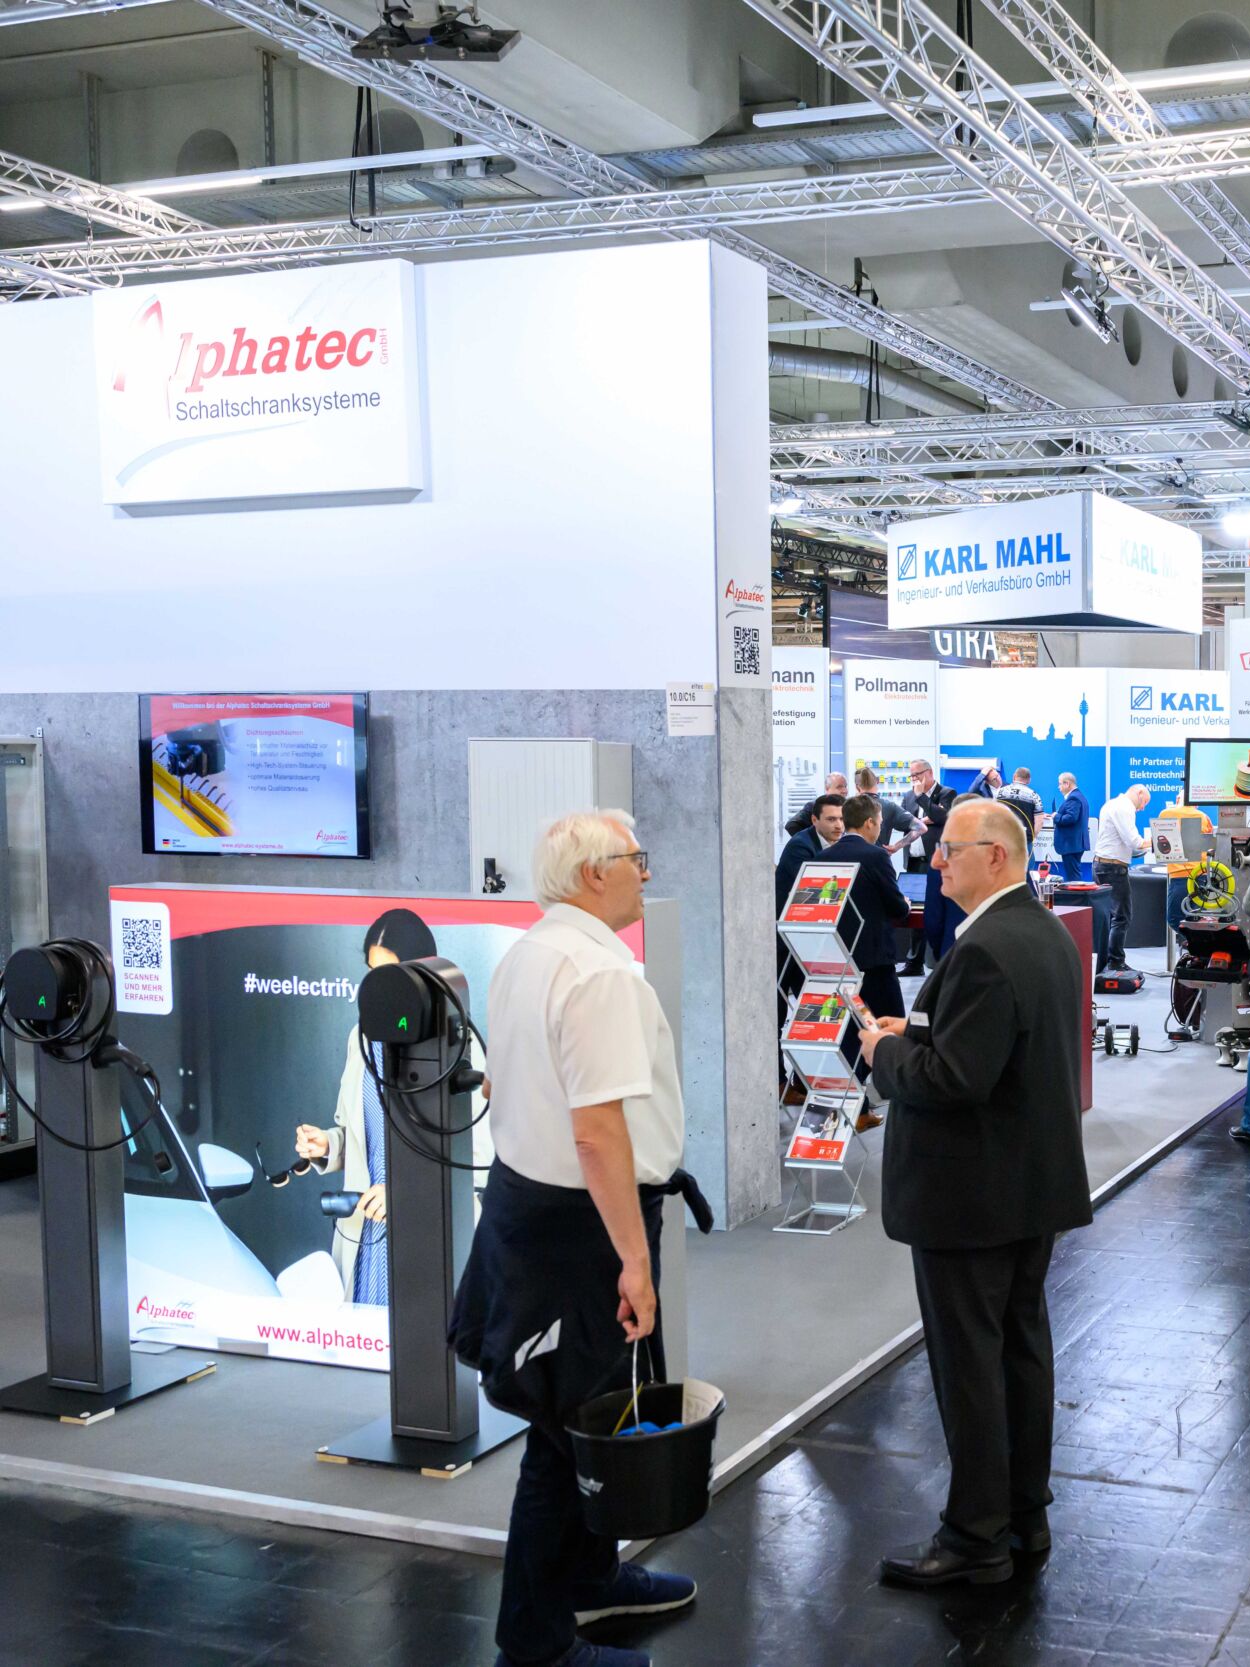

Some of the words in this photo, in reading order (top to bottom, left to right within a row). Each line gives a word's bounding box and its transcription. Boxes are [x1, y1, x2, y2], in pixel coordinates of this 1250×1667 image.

[379, 328, 388, 365] GmbH
[175, 391, 381, 422] Schaltschranksysteme
[925, 544, 988, 578] KARL
[996, 533, 1071, 569] MAHL
[725, 579, 765, 603] Alphatec
[897, 586, 943, 605] Ingenieur-
[945, 581, 963, 596] und
[966, 576, 1033, 595] Verkaufsbüro
[1036, 570, 1071, 588] GmbH
[934, 631, 999, 660] GIRA
[855, 677, 928, 692] Pollmann
[1161, 693, 1224, 711] KARL
[772, 710, 816, 719] efestigung
[894, 718, 930, 726] Verbinden
[1130, 714, 1180, 727] Ingenieur-
[1182, 716, 1201, 726] und
[1130, 757, 1141, 766] Ihr
[1143, 757, 1173, 766] Partner
[124, 973, 159, 982] SCANNEN
[124, 983, 140, 991] UND
[141, 984, 163, 992] MEHR
[244, 973, 360, 1002] #weelectrify
[125, 992, 164, 1002] ERFAHREN
[136, 1296, 195, 1320] Alphatec
[257, 1324, 391, 1352] www.alphatec-
